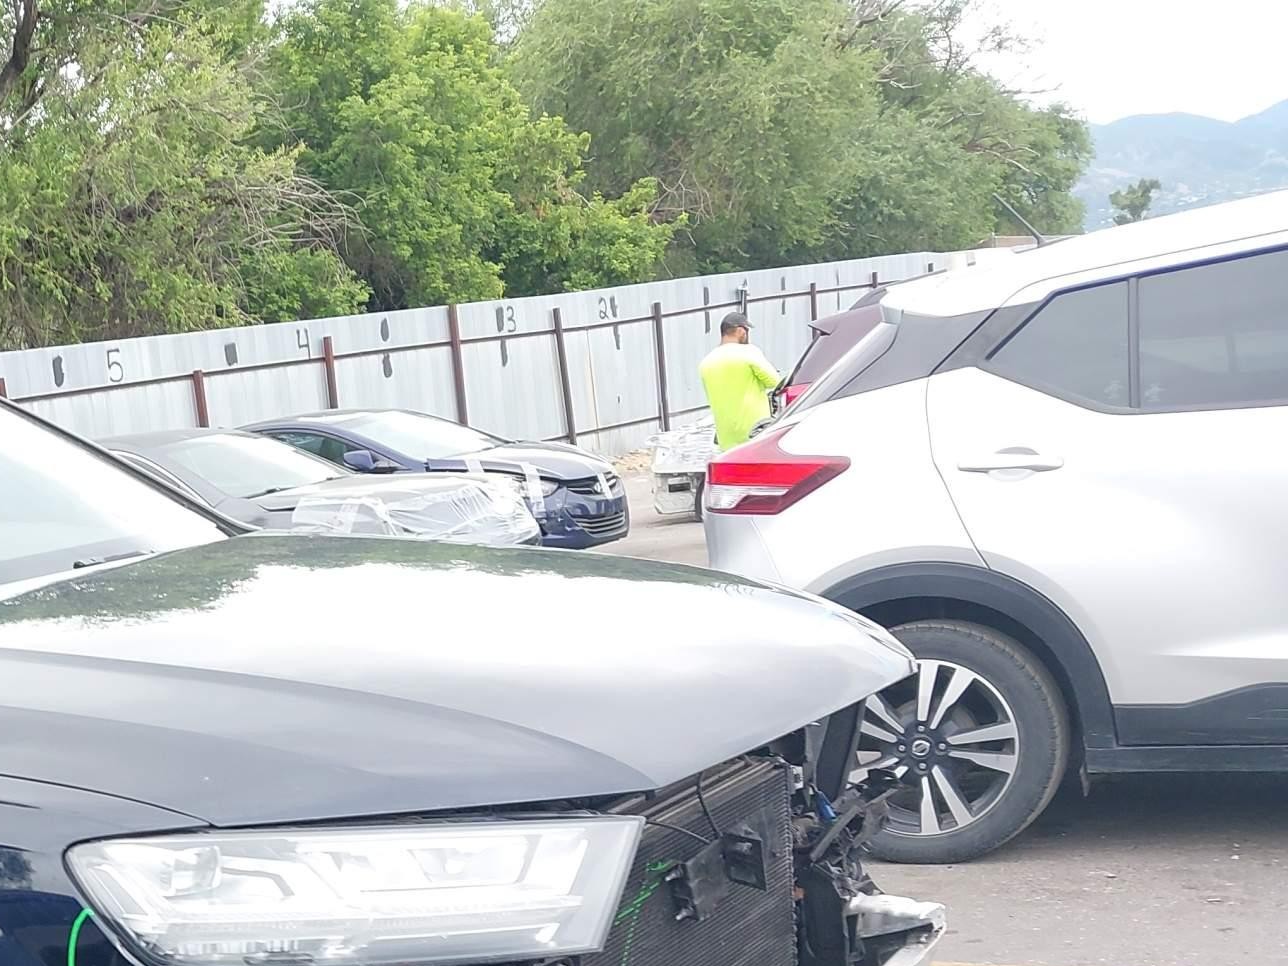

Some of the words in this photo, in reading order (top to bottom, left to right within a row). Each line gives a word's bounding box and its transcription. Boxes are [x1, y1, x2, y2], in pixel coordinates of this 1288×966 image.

[506, 305, 517, 333] 3
[296, 327, 311, 360] 4
[106, 347, 124, 383] 5
